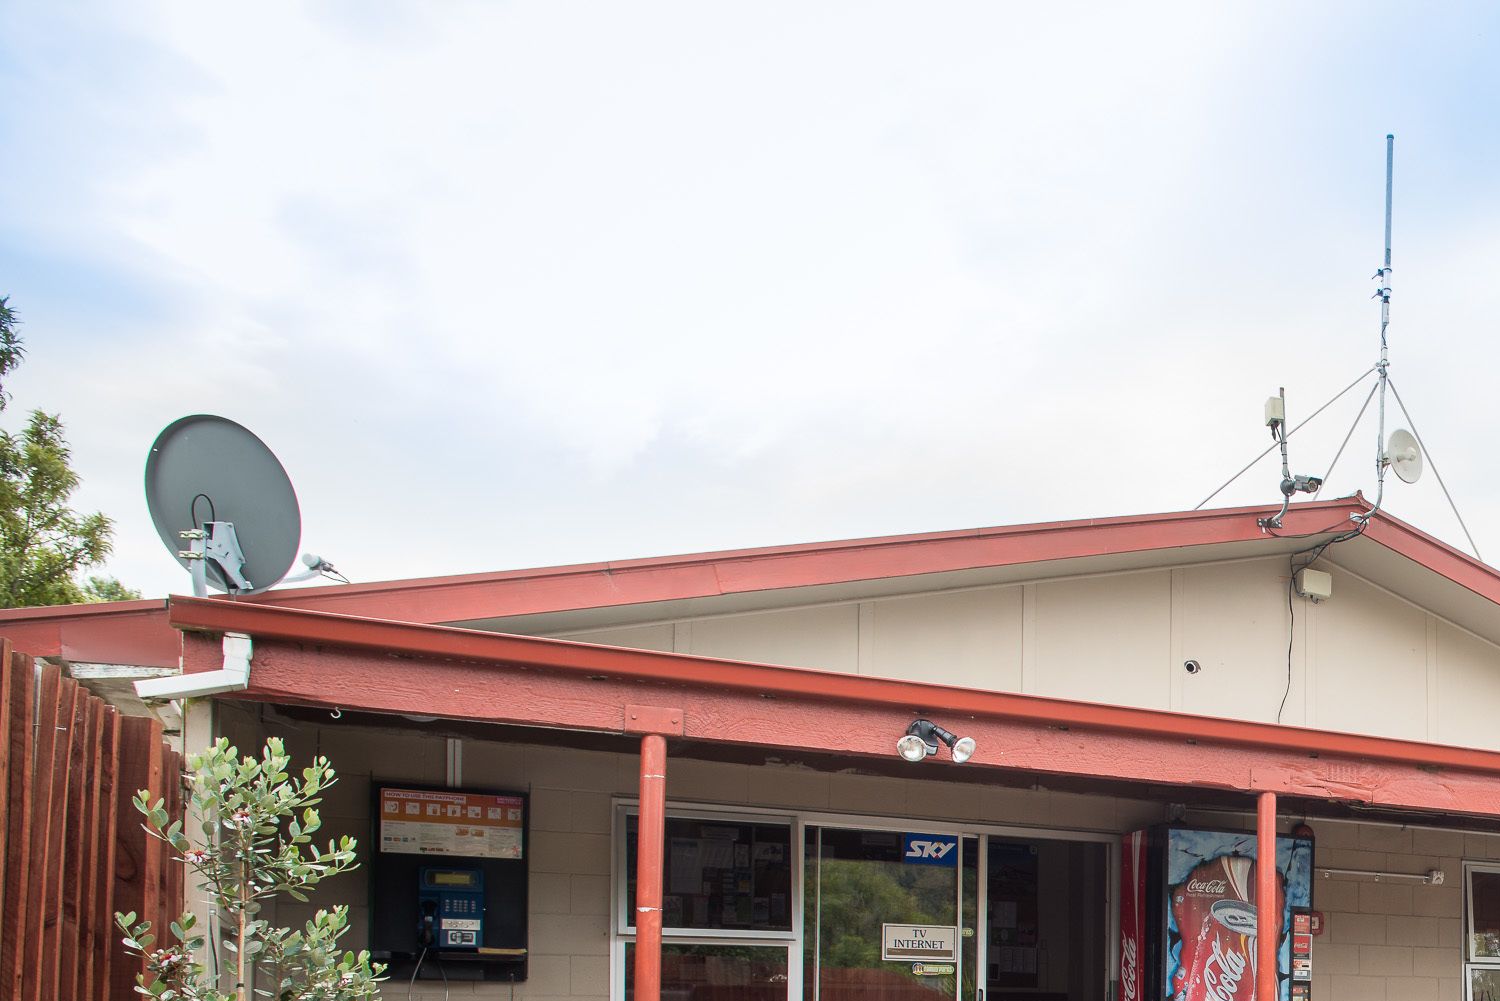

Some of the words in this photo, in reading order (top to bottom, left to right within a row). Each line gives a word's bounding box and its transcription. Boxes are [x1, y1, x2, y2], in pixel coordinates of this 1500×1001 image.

[906, 840, 957, 858] SKY
[1187, 878, 1229, 893] Coca-Cola
[912, 929, 927, 938] TV
[894, 939, 945, 949] INTERNET
